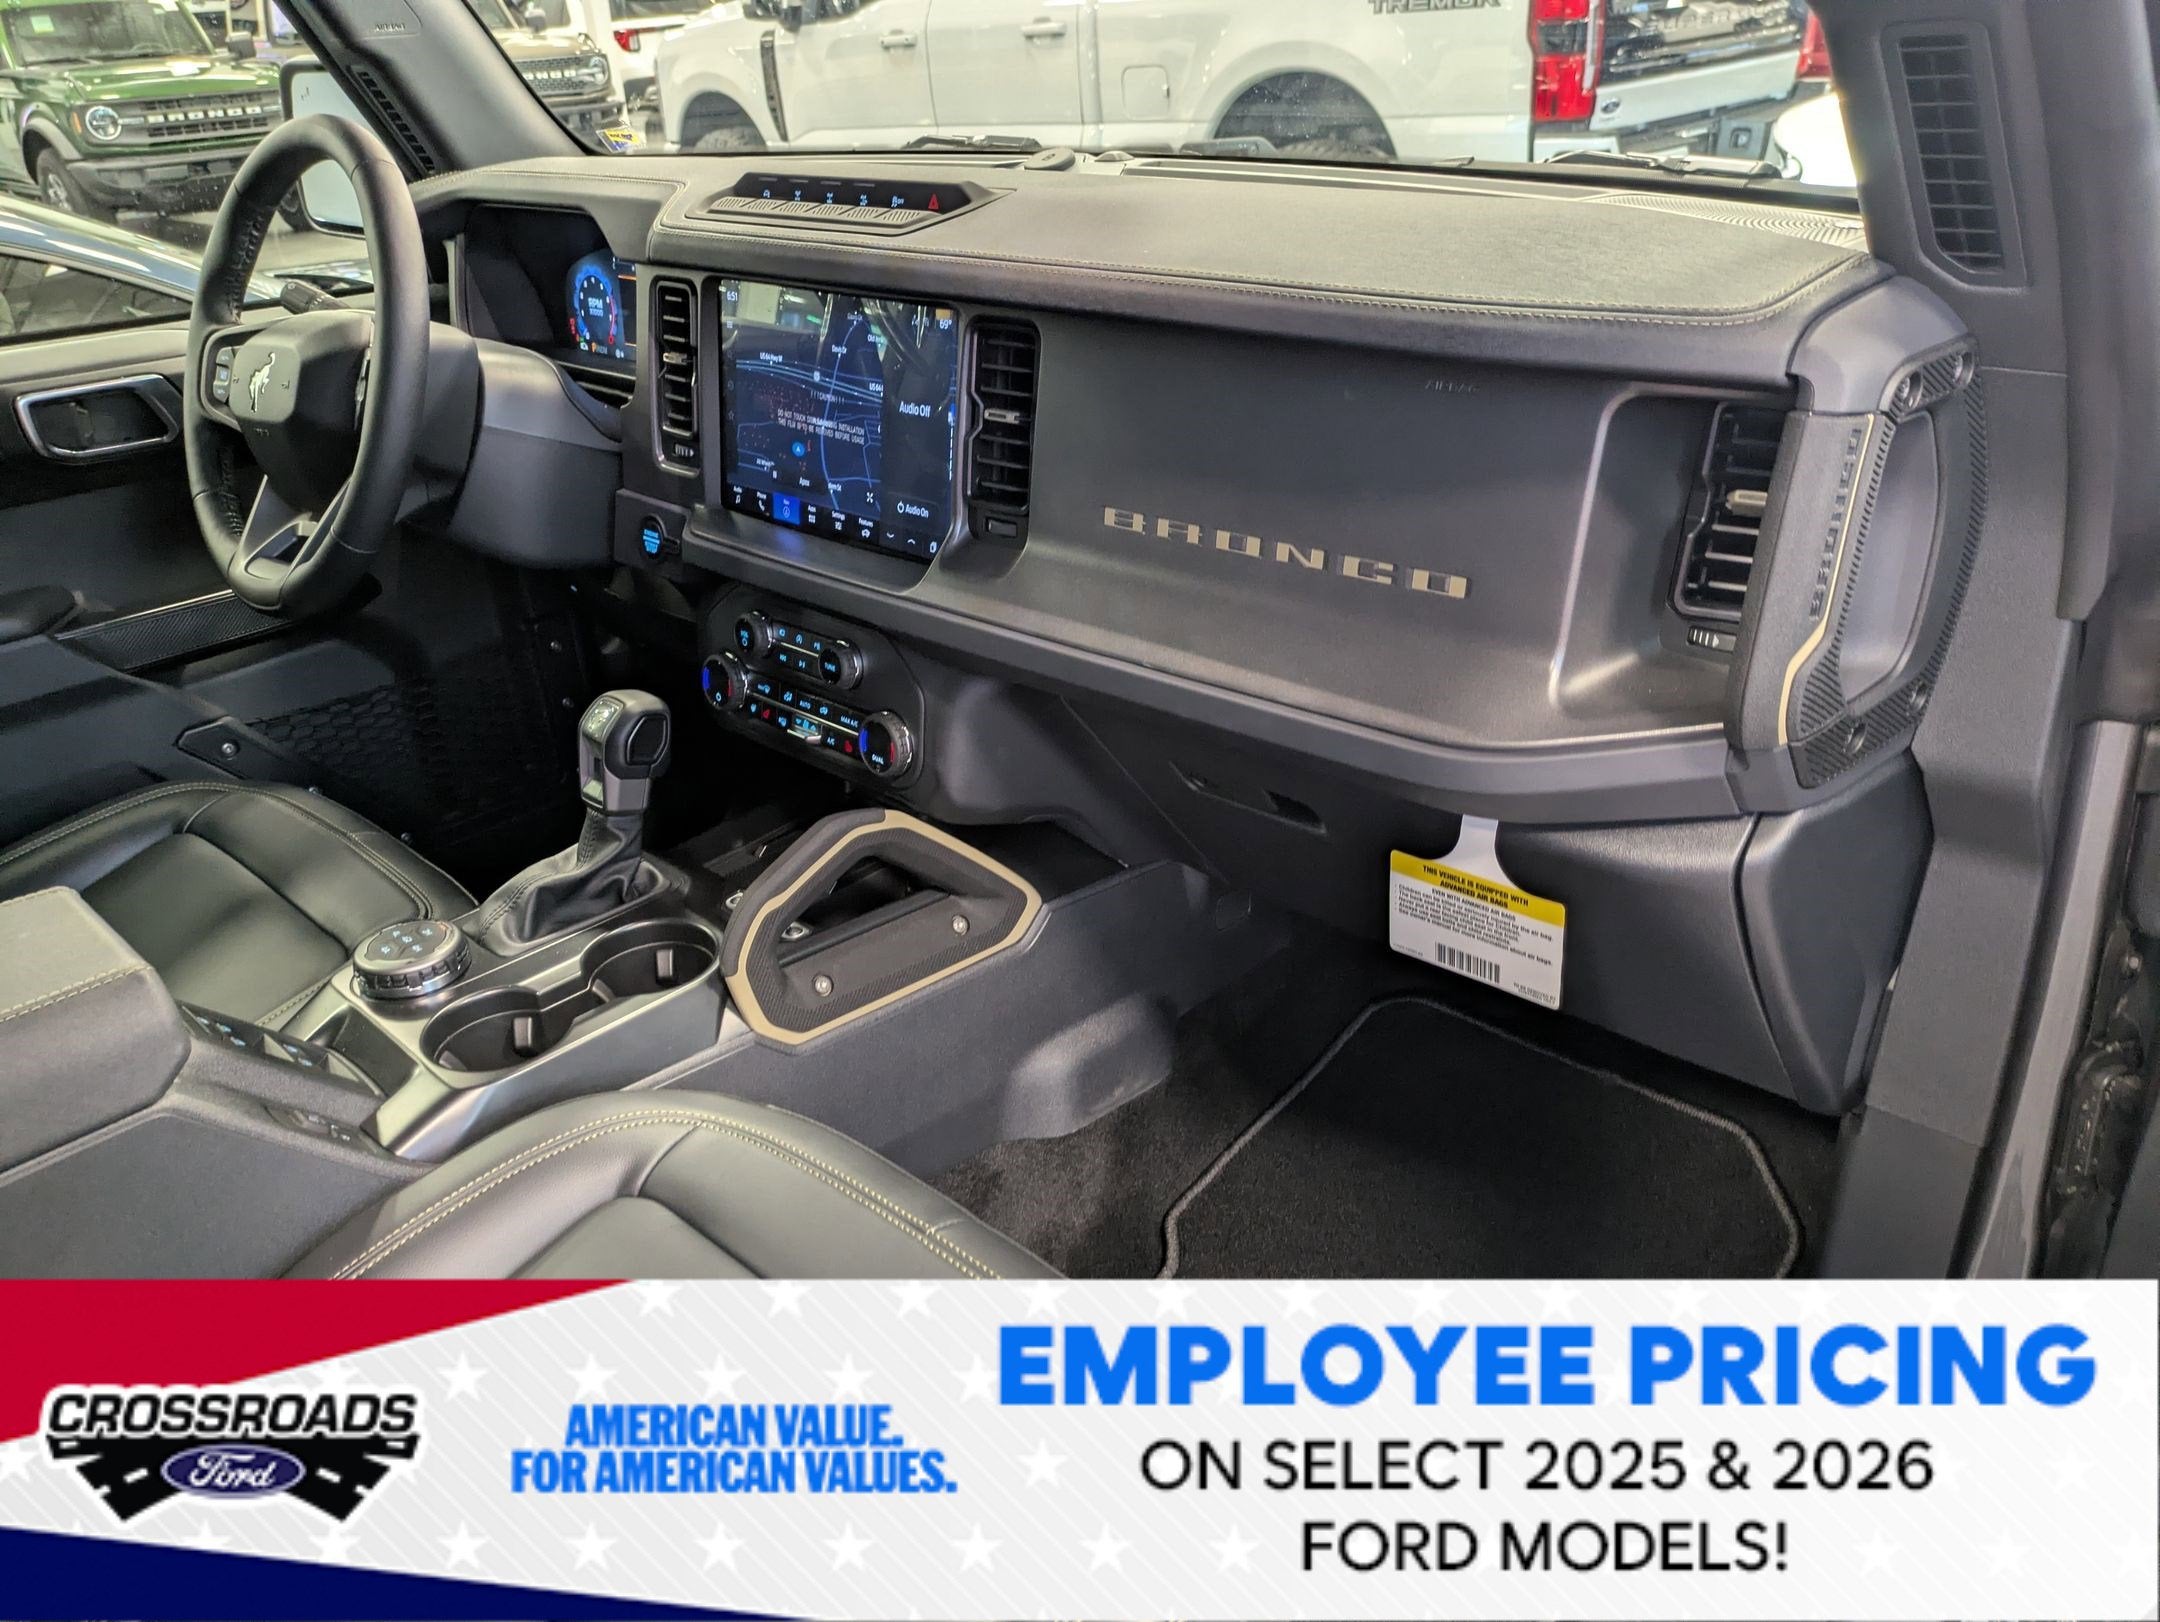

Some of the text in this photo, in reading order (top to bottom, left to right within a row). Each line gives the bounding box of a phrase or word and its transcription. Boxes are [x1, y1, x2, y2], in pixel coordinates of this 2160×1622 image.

[899, 401, 931, 417] Audio Off
[905, 504, 929, 518] Audio On
[1809, 428, 1862, 621] BRONCO
[1103, 507, 1469, 599] BRONCO
[799, 700, 811, 710] AUTO
[850, 718, 859, 728] A/C
[827, 736, 836, 746] A/C
[872, 753, 884, 765] DUAL
[1423, 865, 1528, 906] THIS VEHICLE IS EQUIPPED WITH
[1440, 880, 1508, 908] ADVANCED AIR BAGS
